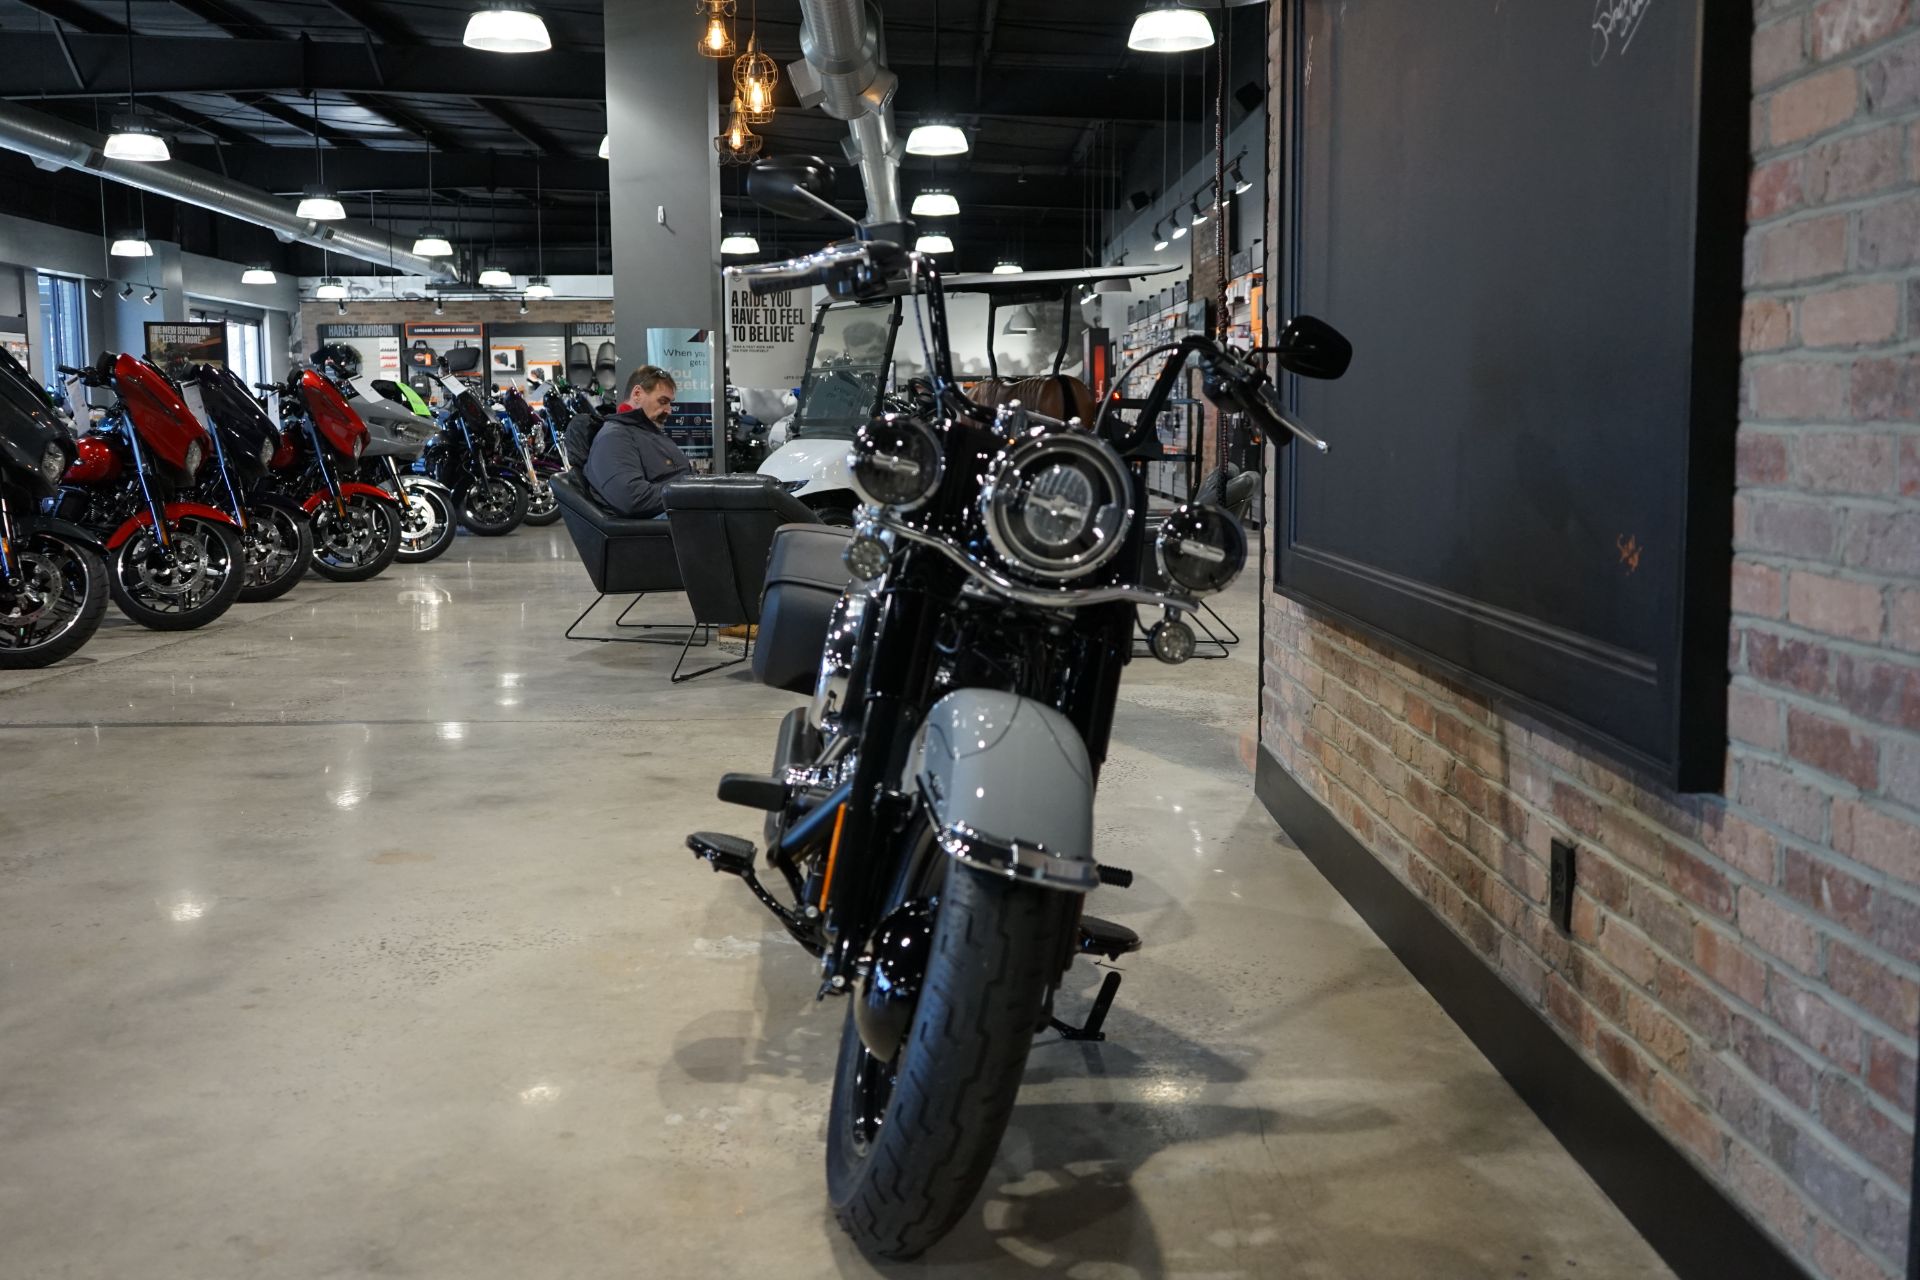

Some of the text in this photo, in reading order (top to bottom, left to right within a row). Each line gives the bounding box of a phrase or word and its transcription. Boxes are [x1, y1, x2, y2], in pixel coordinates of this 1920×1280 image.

[731, 290, 792, 308] A RIDE YOU
[731, 308, 806, 325] HAVE TO FEEL
[162, 325, 177, 335] NEW
[177, 326, 211, 336] DEFINITION
[328, 324, 394, 337] HARLEY-DAVIDSON
[731, 325, 795, 343] TO BELIEVE
[177, 335, 184, 344] IS
[663, 349, 692, 357] When
[689, 360, 701, 368] get
